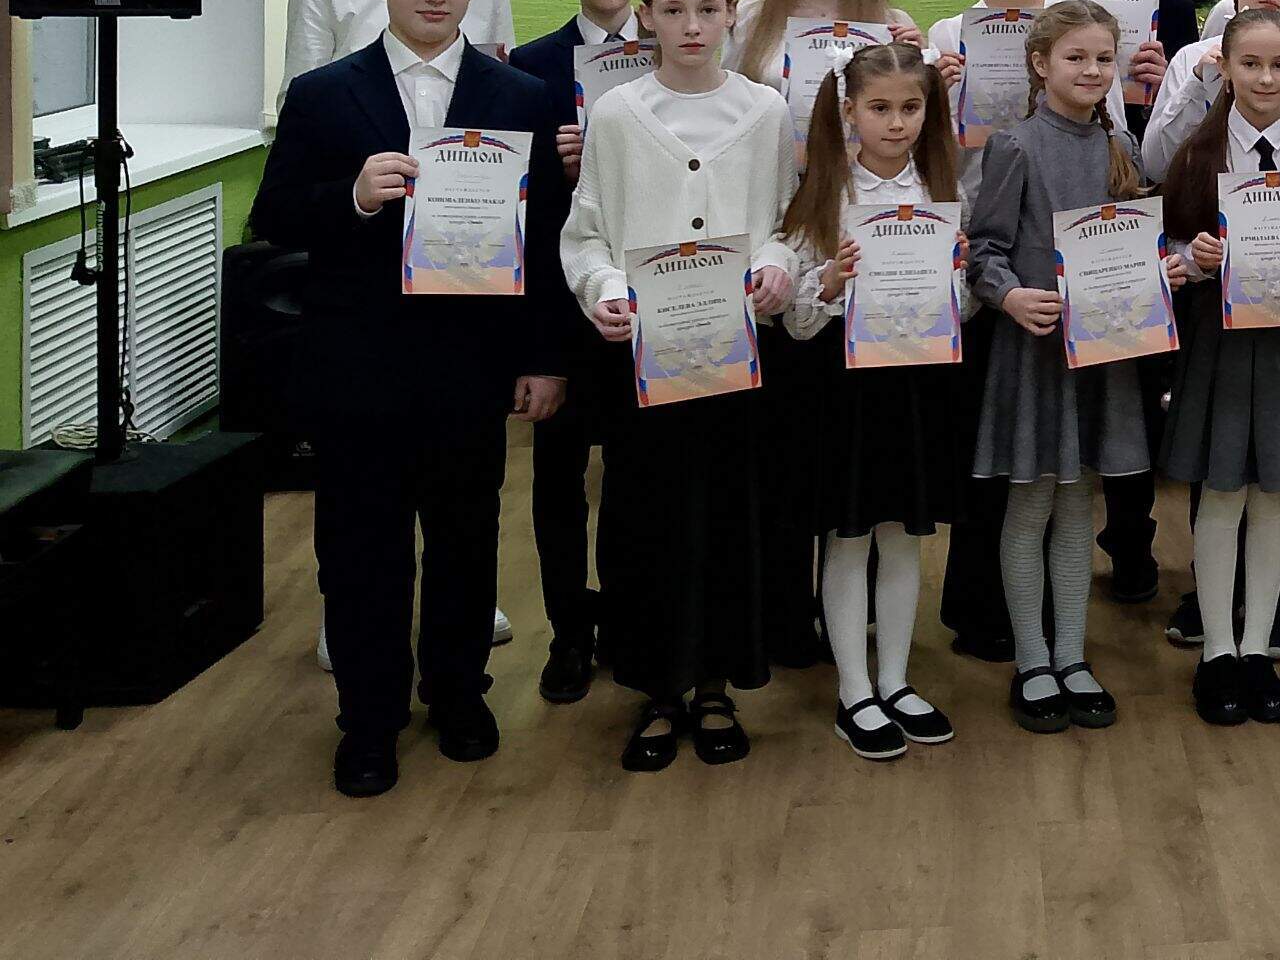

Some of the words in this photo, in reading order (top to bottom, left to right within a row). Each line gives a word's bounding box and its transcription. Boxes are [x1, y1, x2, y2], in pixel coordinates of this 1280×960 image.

[599, 56, 652, 73] ДИПЛО
[435, 149, 504, 164] ДИПЛОМ
[872, 223, 936, 238] ДИПЛОМ
[1078, 218, 1140, 240] ДИПЛОМ
[653, 254, 724, 277] ДИПЛОМ
